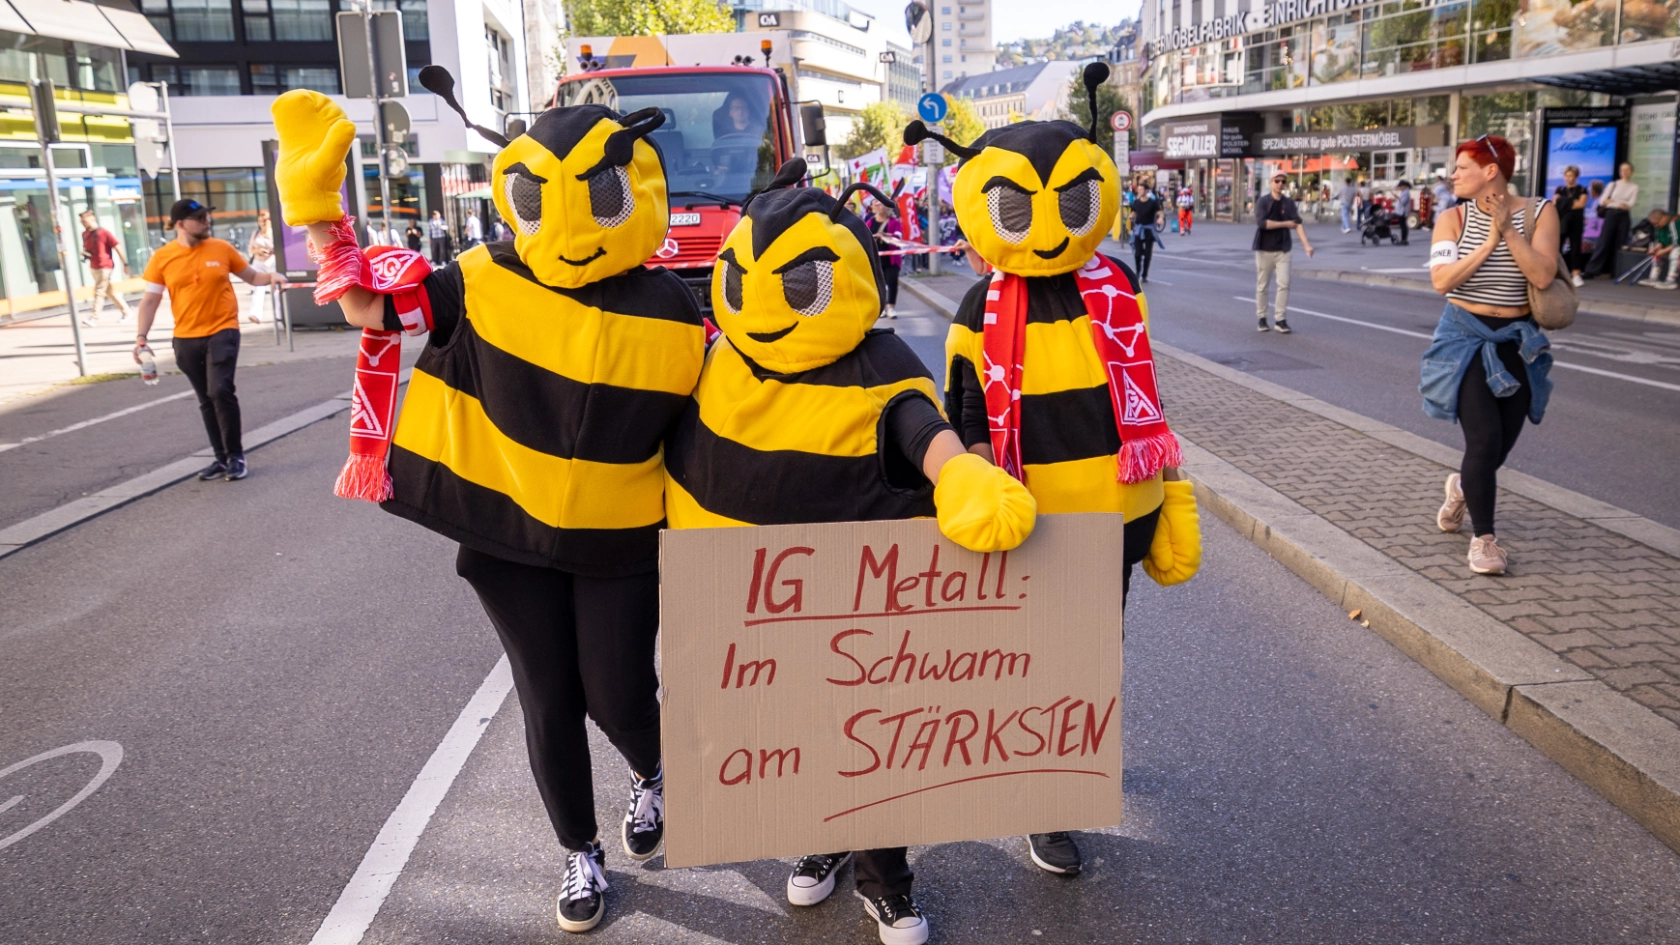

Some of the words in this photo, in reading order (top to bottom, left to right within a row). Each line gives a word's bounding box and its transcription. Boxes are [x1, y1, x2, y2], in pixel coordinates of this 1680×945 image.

[1262, 136, 1310, 150] SPEZIALFABRIK
[1310, 137, 1321, 149] für
[1321, 137, 1337, 150] gute
[1337, 131, 1402, 148] POLSTERMÖBEL
[671, 214, 699, 223] 2220
[746, 545, 815, 614] IG
[853, 543, 1031, 612] Metall:
[720, 642, 777, 690] Im
[825, 628, 1031, 687] Schwarm
[718, 746, 801, 786] am
[837, 695, 1117, 778] STÄRKSTEN
